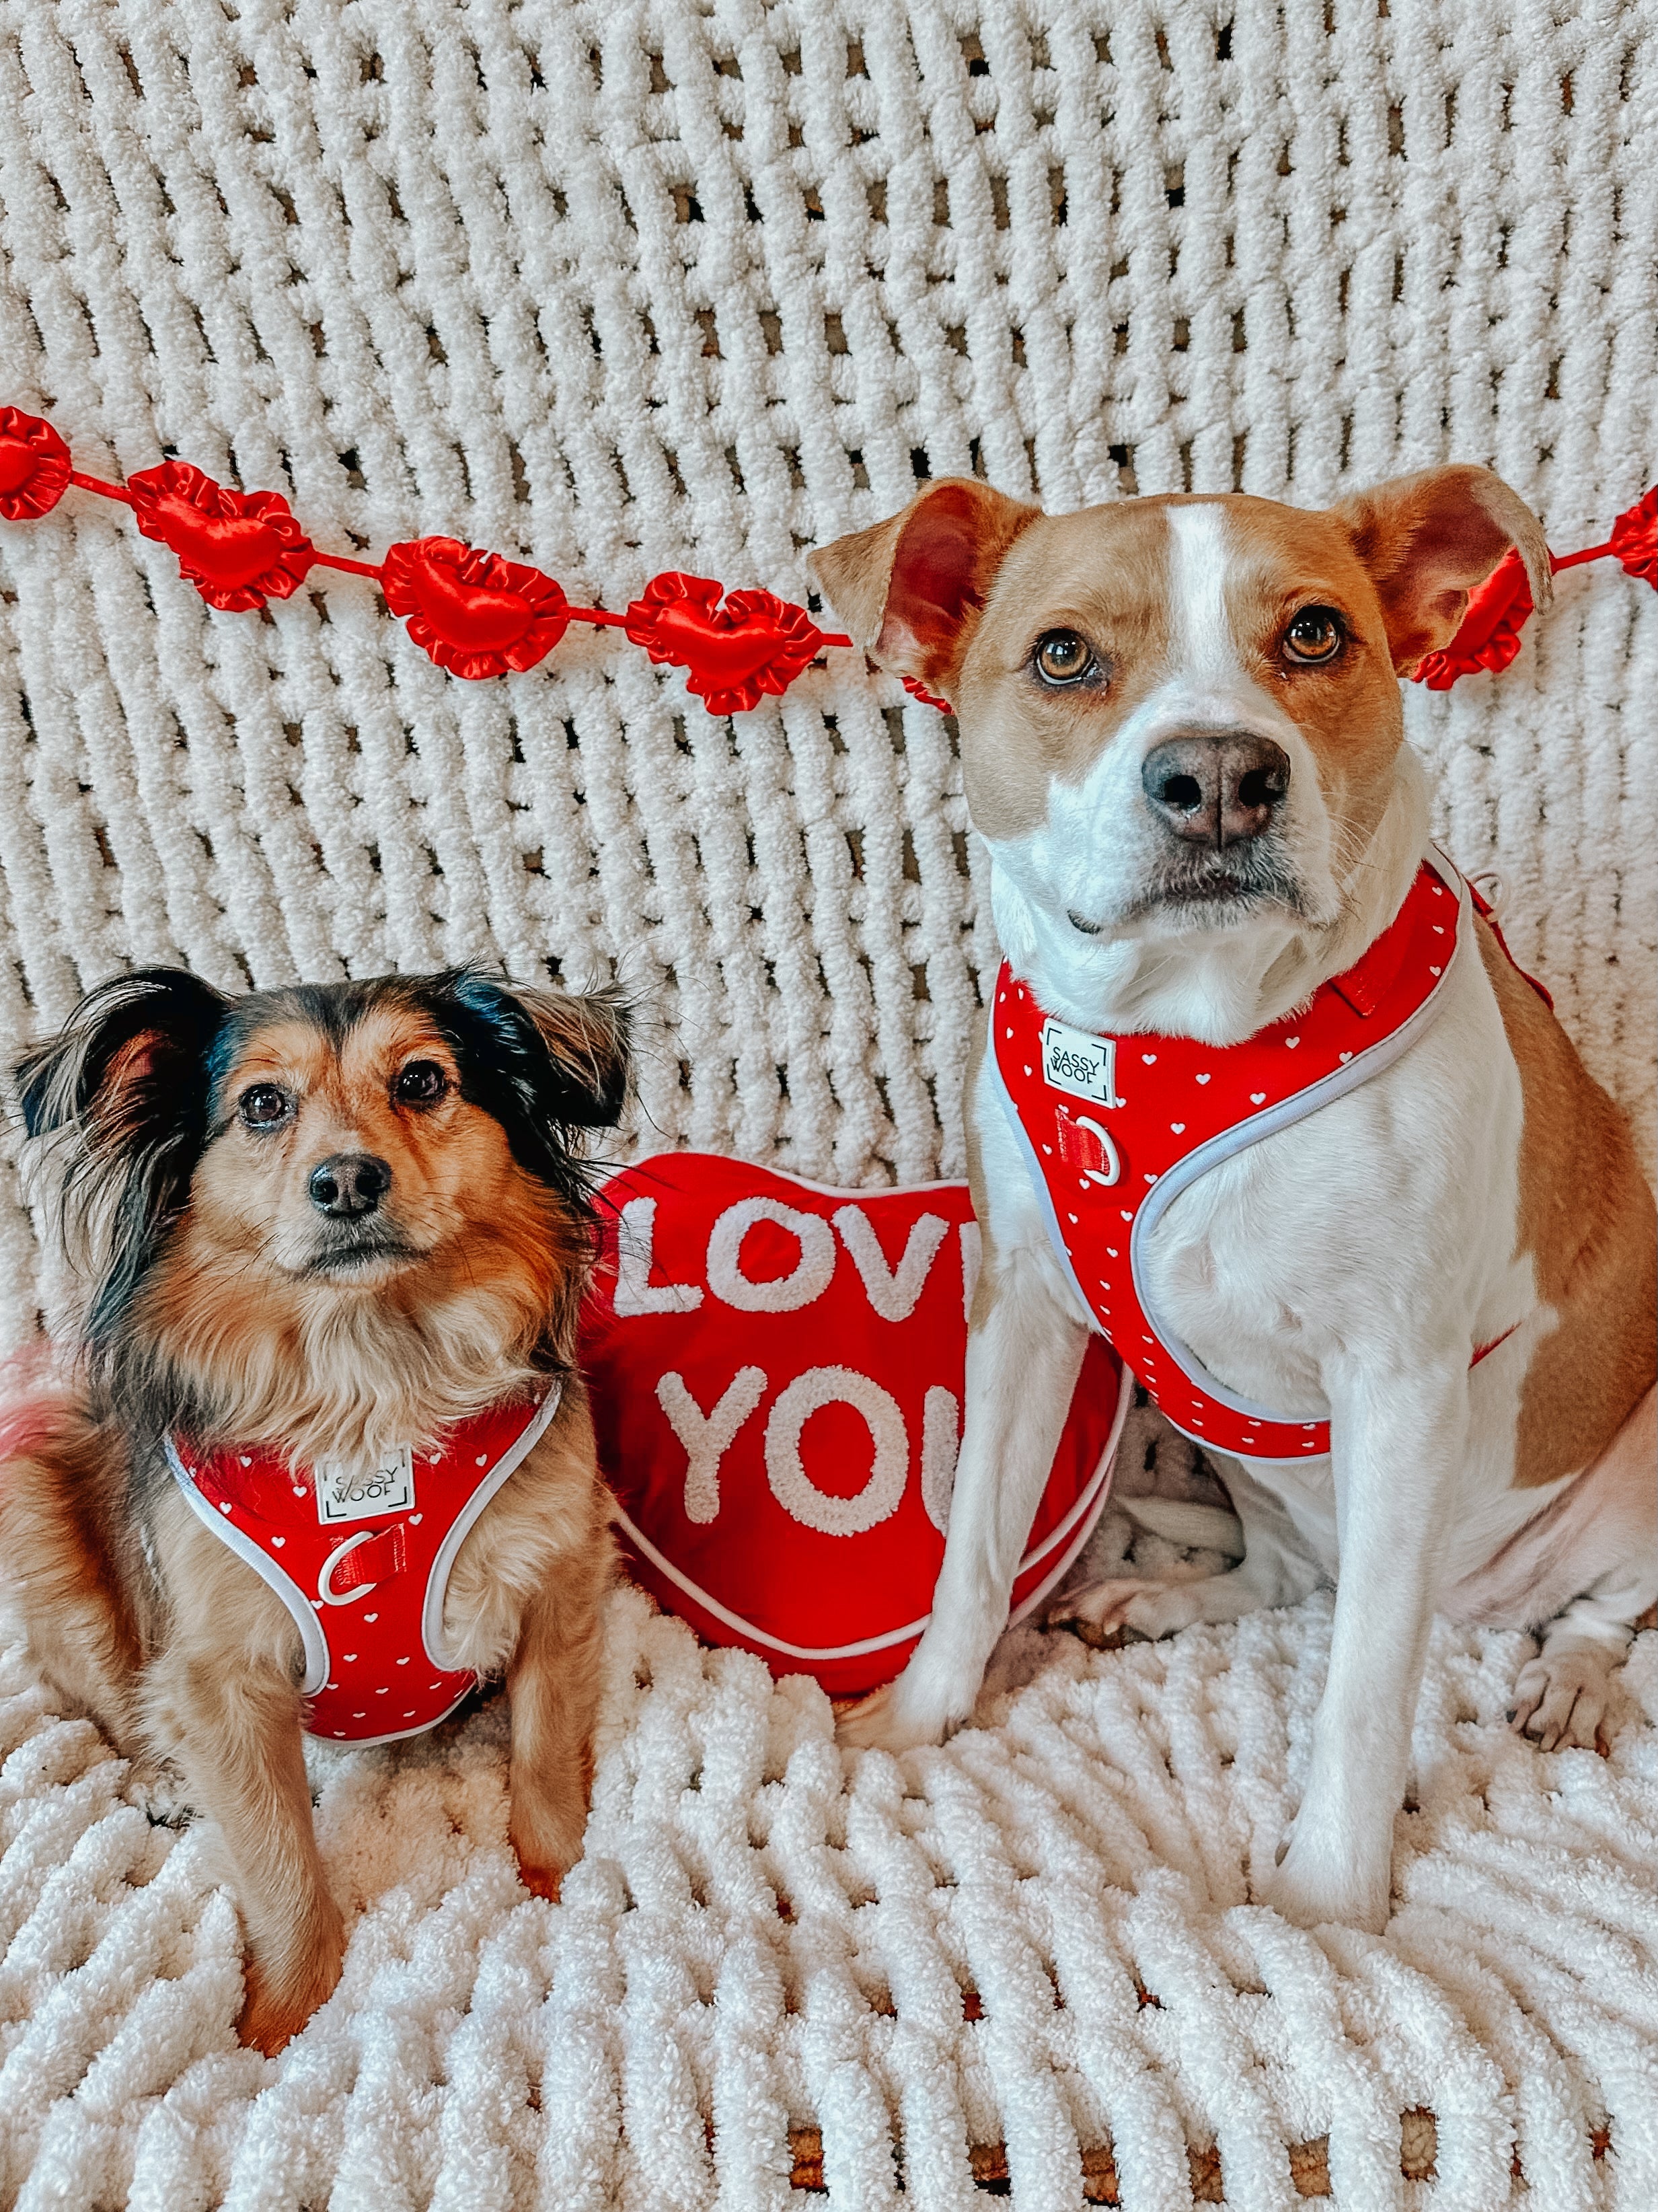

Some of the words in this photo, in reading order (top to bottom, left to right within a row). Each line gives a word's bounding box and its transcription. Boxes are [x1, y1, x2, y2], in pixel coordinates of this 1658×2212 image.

[1050, 1056, 1097, 1084] WOOF
[1053, 1046, 1100, 1074] SASSY
[613, 1196, 981, 1323] LOV
[332, 1479, 395, 1504] WOOF
